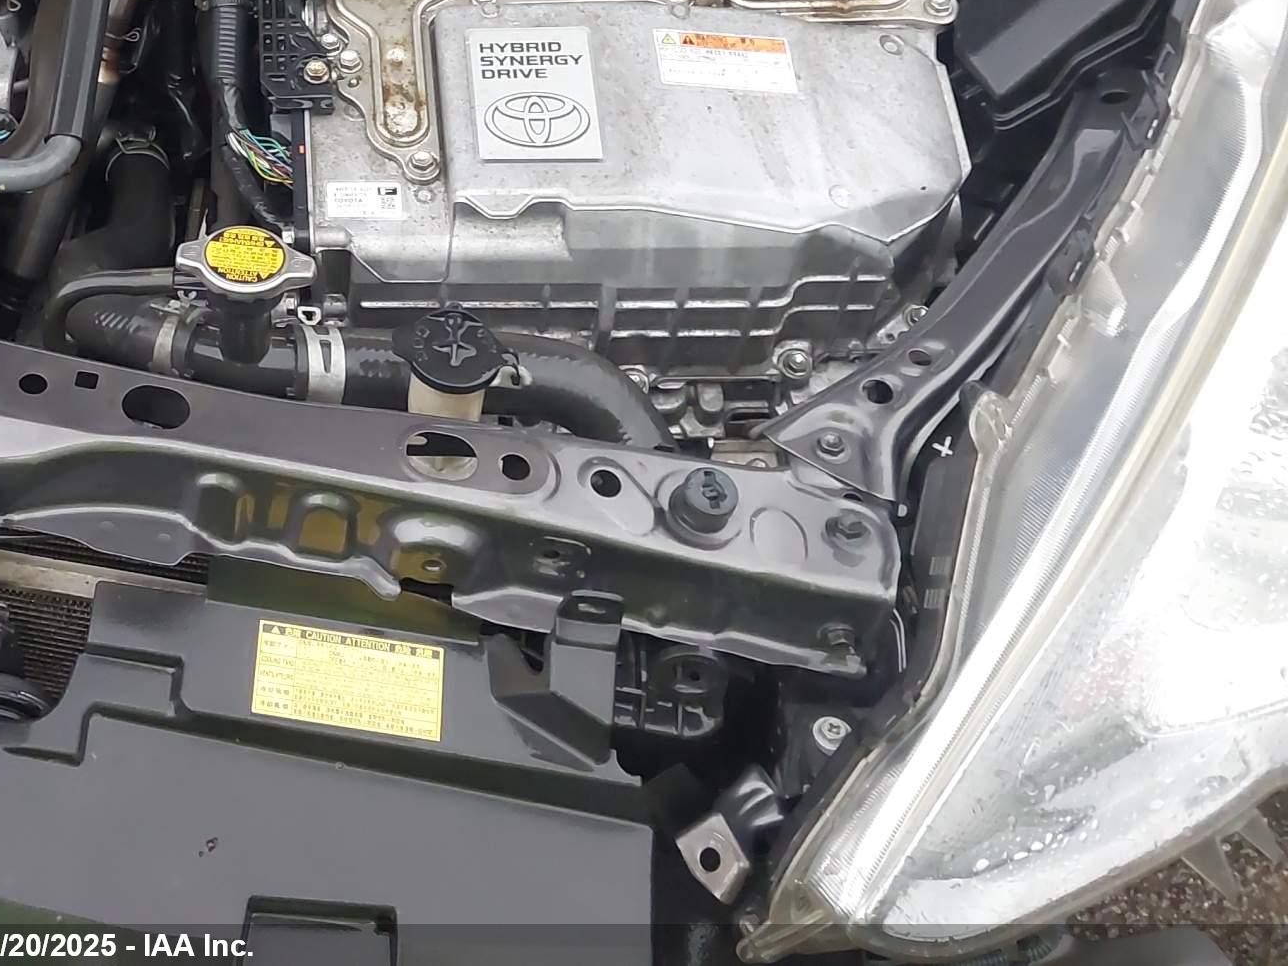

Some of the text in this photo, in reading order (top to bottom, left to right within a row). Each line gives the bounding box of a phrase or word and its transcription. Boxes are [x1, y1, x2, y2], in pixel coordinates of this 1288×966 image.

[479, 41, 562, 54] HYBRID
[480, 54, 584, 67] SYNERGY
[481, 67, 548, 80] DRIVE
[217, 266, 259, 276] ATTENTION
[225, 273, 258, 282] CAUTION
[305, 630, 342, 644] CAUTION
[344, 638, 391, 653] ATTENTION
